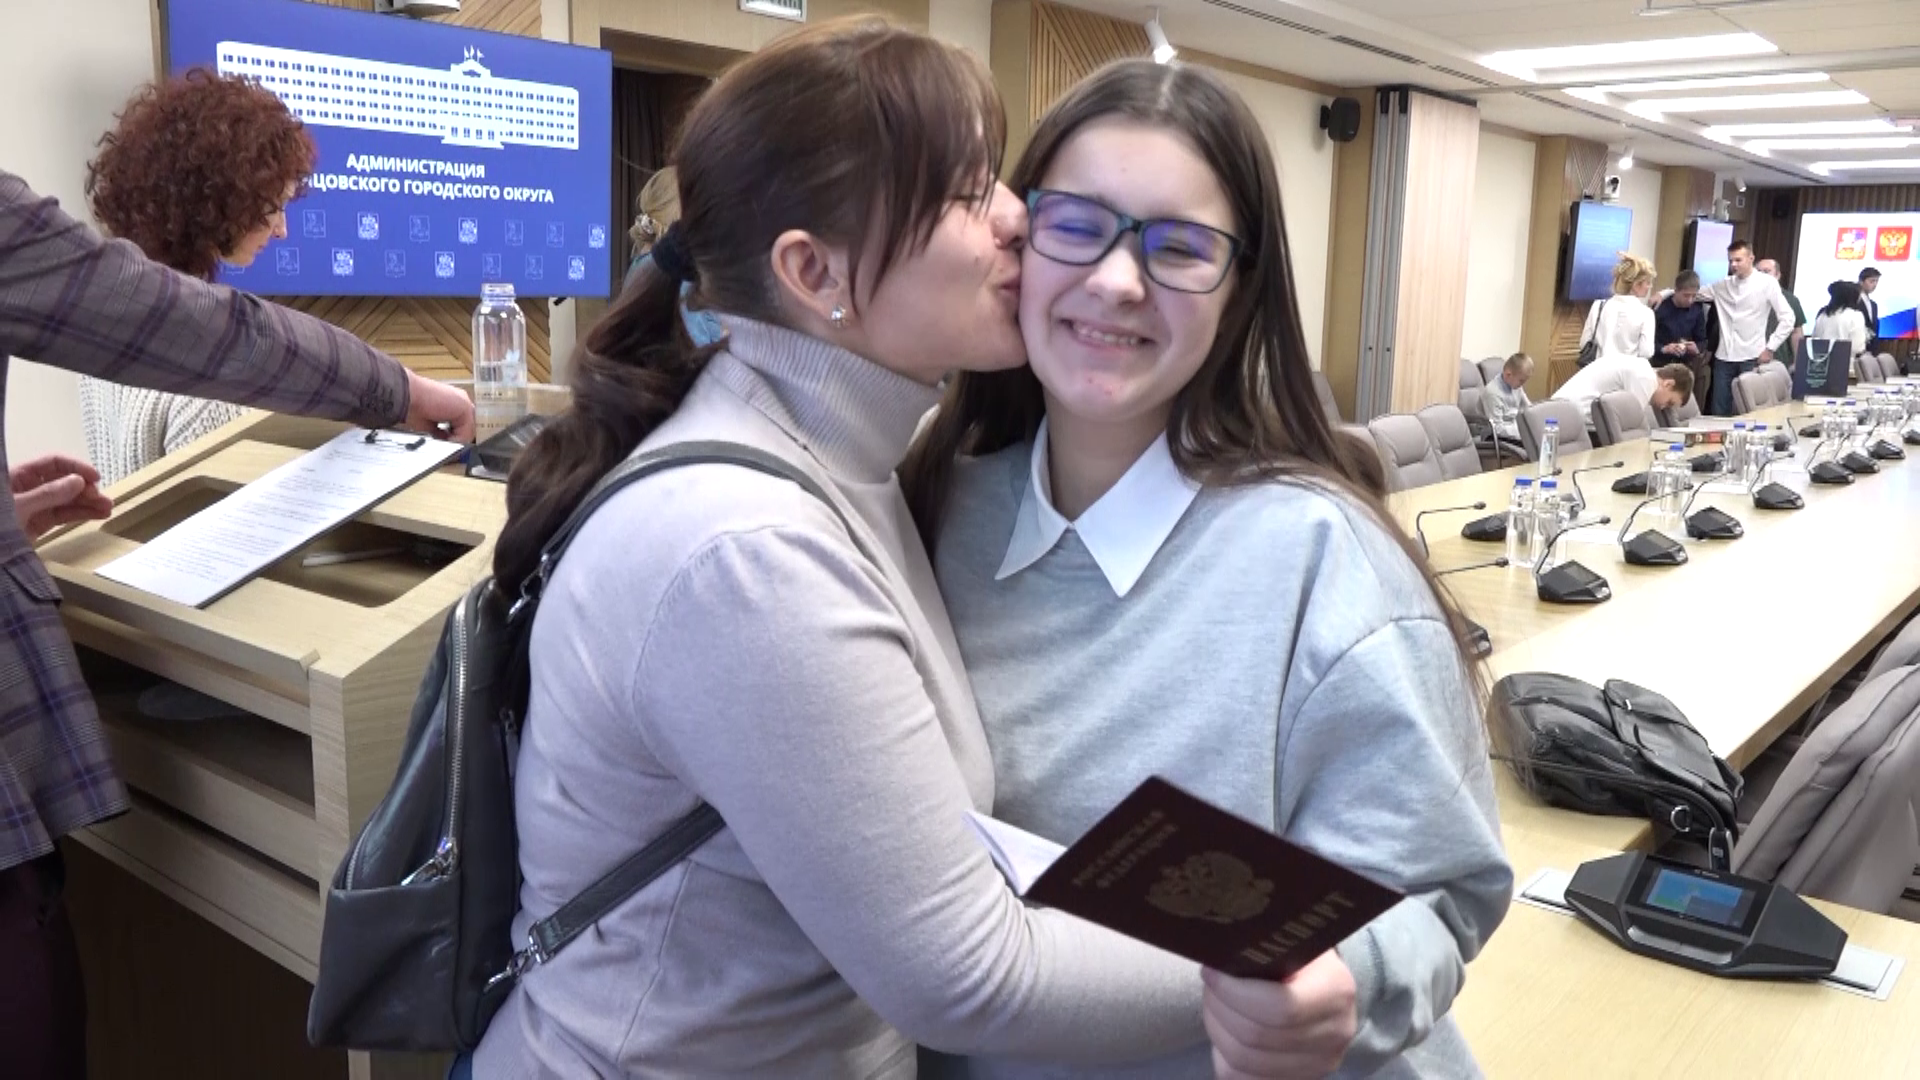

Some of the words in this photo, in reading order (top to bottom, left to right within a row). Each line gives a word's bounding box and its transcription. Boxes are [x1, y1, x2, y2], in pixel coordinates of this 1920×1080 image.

[346, 153, 485, 179] АДМИНИСТРАЦИЯ
[404, 180, 500, 200] ГОРОДСКОГО
[503, 186, 554, 203] ОКРУГА
[1239, 890, 1354, 966] ПАСПОРТ
